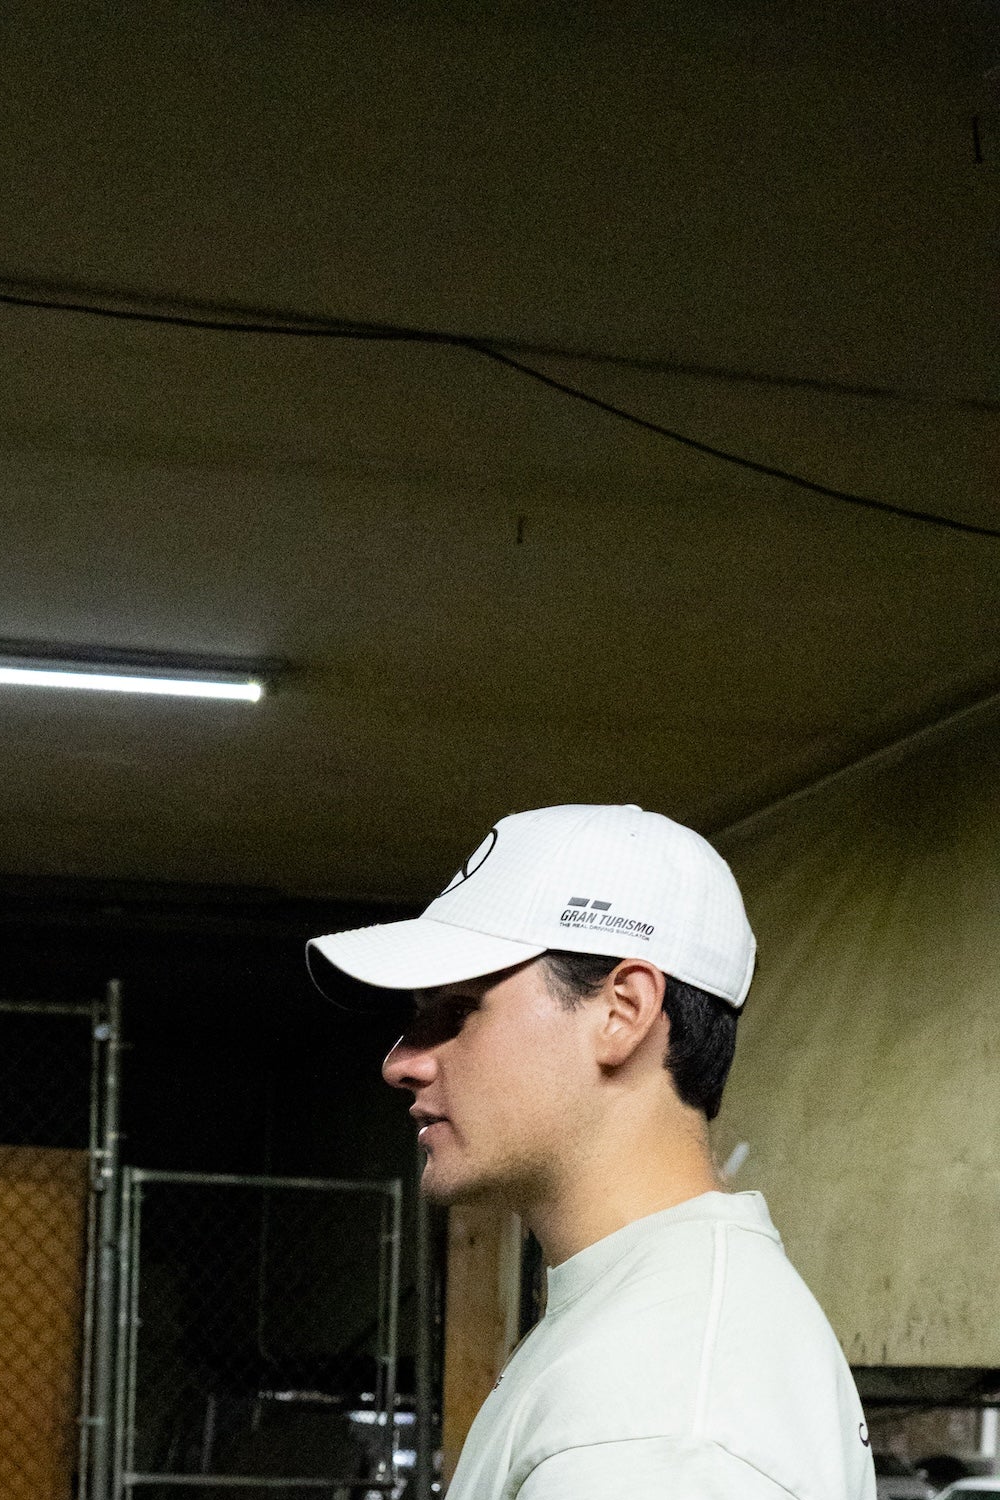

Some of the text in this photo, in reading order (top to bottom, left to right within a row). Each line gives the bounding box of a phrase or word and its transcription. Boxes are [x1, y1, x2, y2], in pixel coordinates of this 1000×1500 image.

[560, 909, 655, 936] GRAN TURISMO
[589, 925, 614, 933] DRIVING
[616, 929, 650, 941] SIMULATOR
